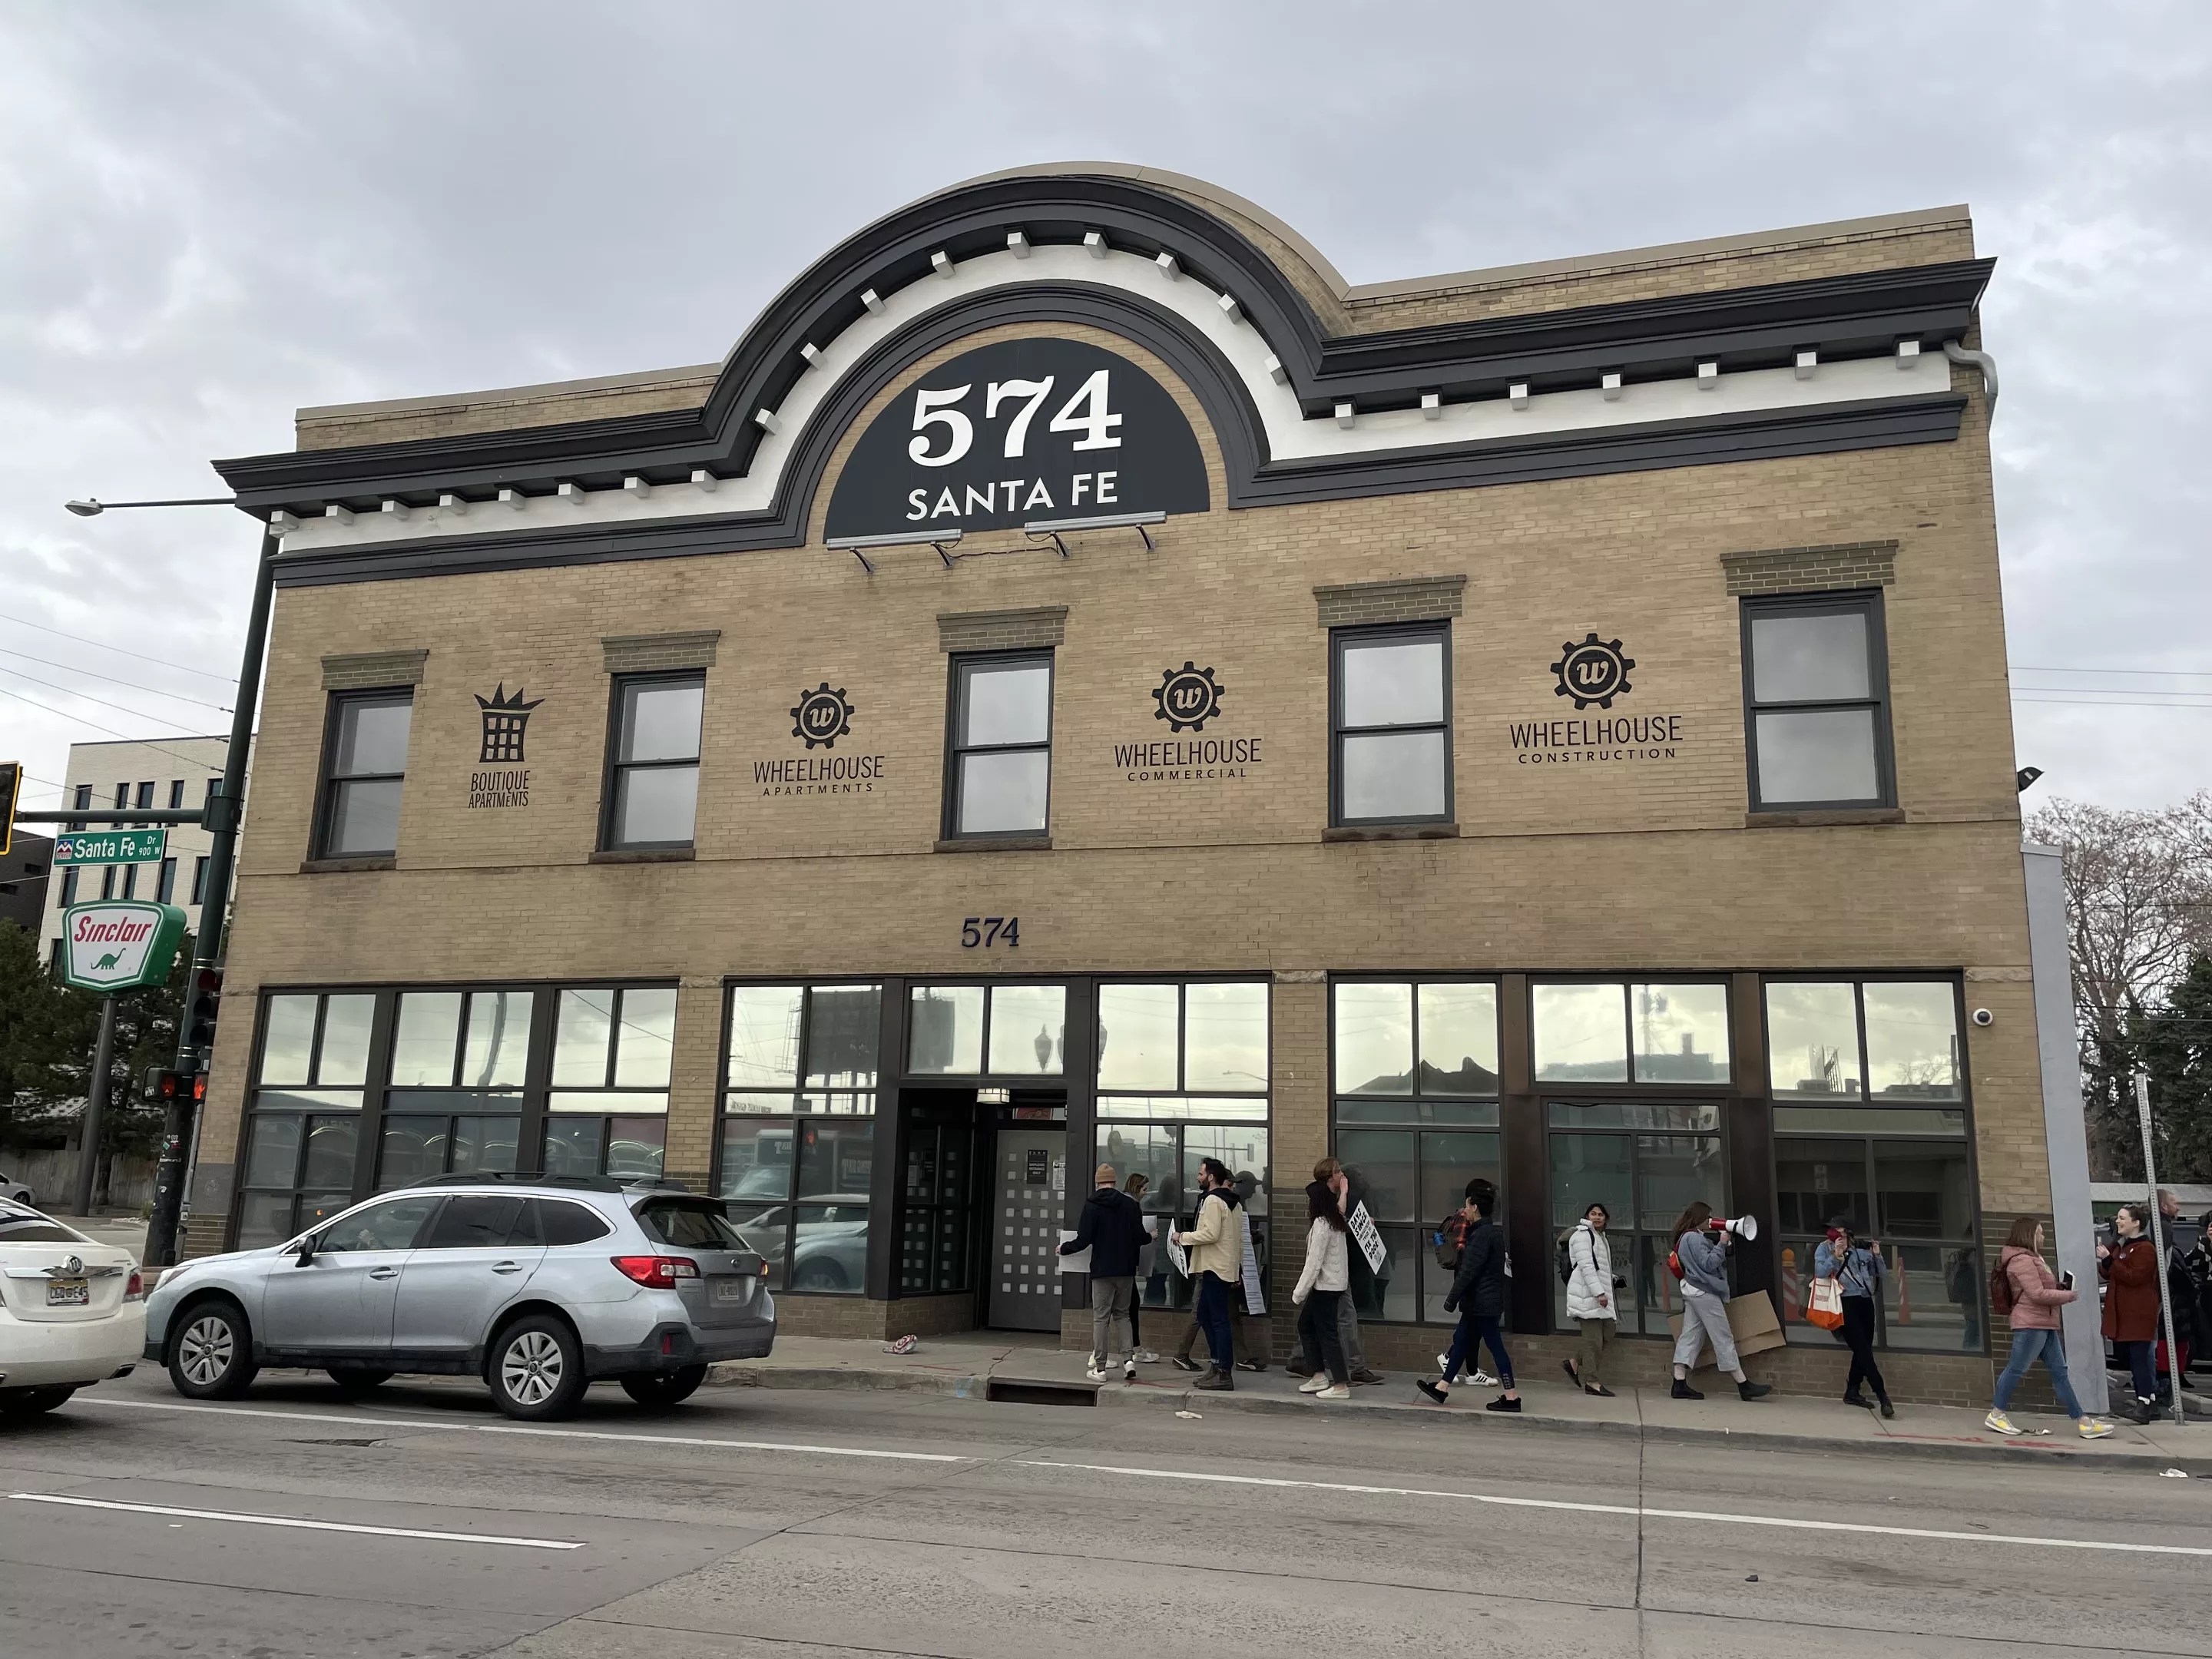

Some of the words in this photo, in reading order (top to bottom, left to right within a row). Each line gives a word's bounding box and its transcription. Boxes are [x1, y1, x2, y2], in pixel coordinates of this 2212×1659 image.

[908, 369, 1122, 467] 574
[906, 477, 1055, 521] SANTA
[1071, 471, 1118, 506] FE
[1510, 715, 1684, 748] WHEELHOUSE
[1114, 738, 1262, 768] WHEELHOUSE
[1518, 748, 1676, 764] CONSTRUCTION
[753, 755, 885, 783] WHEELHOUSE
[1128, 768, 1247, 781] COMMERCIAL
[470, 770, 530, 794] BOUTIQUE
[763, 783, 873, 796] APARTMENTS
[468, 790, 529, 809] APARTMENTS
[74, 838, 115, 859] Santa
[120, 837, 135, 857] Fe
[138, 847, 151, 856] 900
[154, 846, 161, 855] W
[147, 836, 156, 845] Dr
[74, 916, 152, 942] Sinclair
[962, 917, 1019, 947] 574
[1350, 1207, 1362, 1229] DAYS
[1355, 1211, 1367, 1237] SINCE
